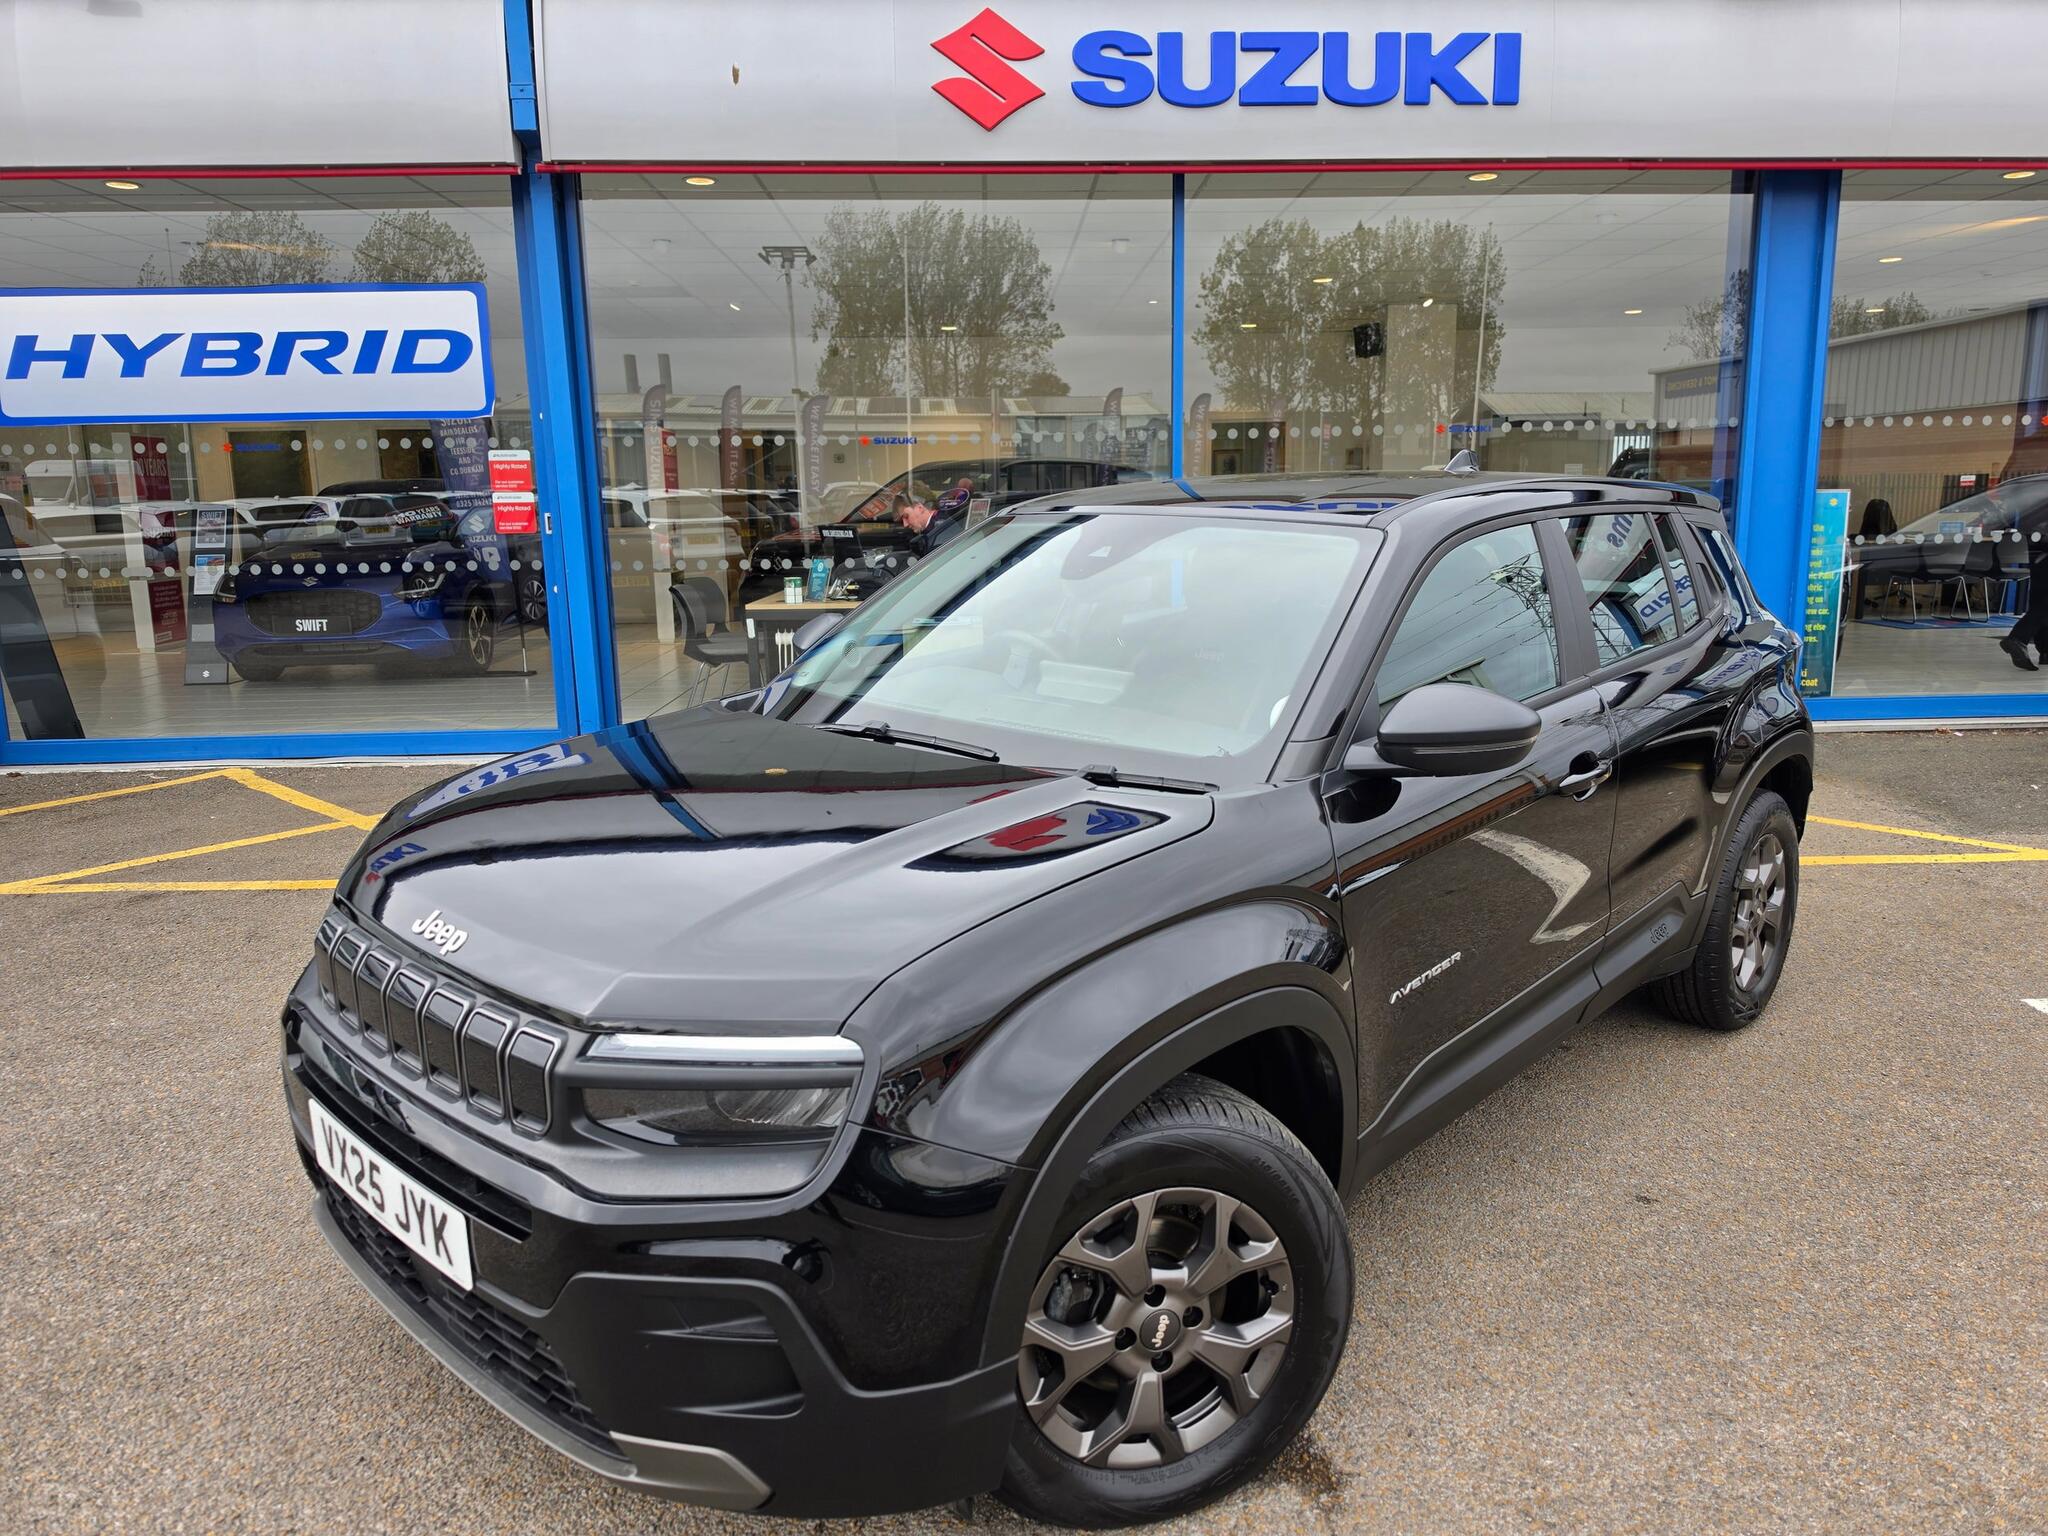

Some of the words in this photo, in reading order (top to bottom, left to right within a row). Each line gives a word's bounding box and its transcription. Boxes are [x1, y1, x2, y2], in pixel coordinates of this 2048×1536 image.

[1071, 29, 1522, 108] SUZUKI
[5, 329, 474, 380] HYBRID
[811, 405, 821, 420] WE
[728, 417, 738, 448] MAE
[810, 422, 820, 453] MAKE
[873, 436, 918, 445] SUZUKI
[810, 466, 821, 492] EASY
[395, 510, 442, 525] WARRANTY
[416, 505, 441, 515] YEARS
[498, 505, 515, 513] Highly
[295, 618, 329, 632] SWIFT
[411, 908, 469, 956] Jeep
[1649, 922, 1669, 945] Jeep
[1389, 951, 1462, 1004] AVENGER
[320, 1116, 385, 1214] VX25
[395, 1183, 453, 1267] JYK
[1151, 1314, 1170, 1348] Jeep
